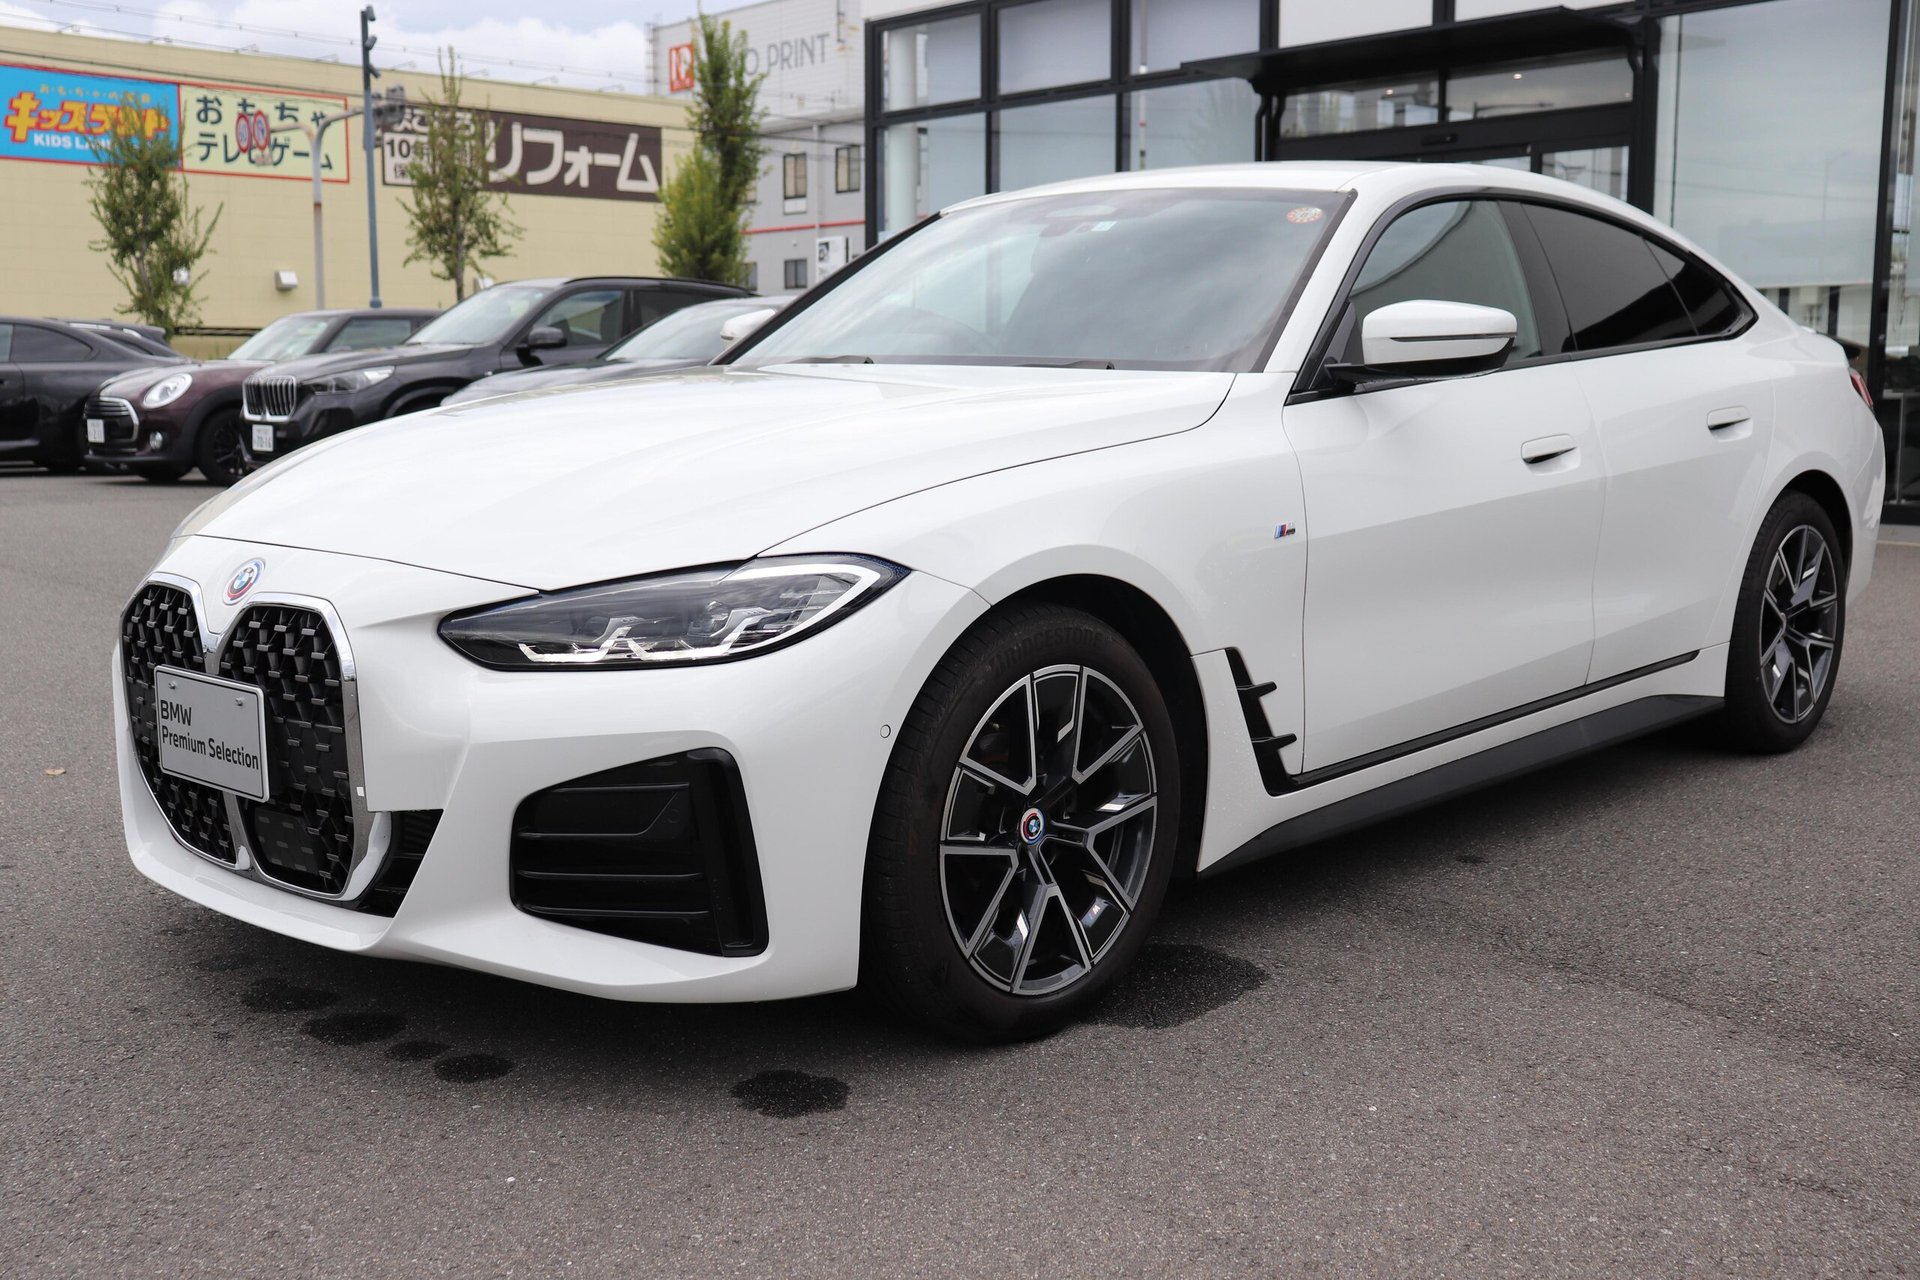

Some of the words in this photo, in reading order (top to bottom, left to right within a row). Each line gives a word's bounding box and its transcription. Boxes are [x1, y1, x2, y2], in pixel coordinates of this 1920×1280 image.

[766, 33, 830, 76] PRINT
[33, 133, 72, 150] KIDS
[485, 120, 660, 194] リフォーム
[160, 699, 192, 726] BMW
[161, 725, 206, 755] Premium
[208, 737, 259, 770] Selection
